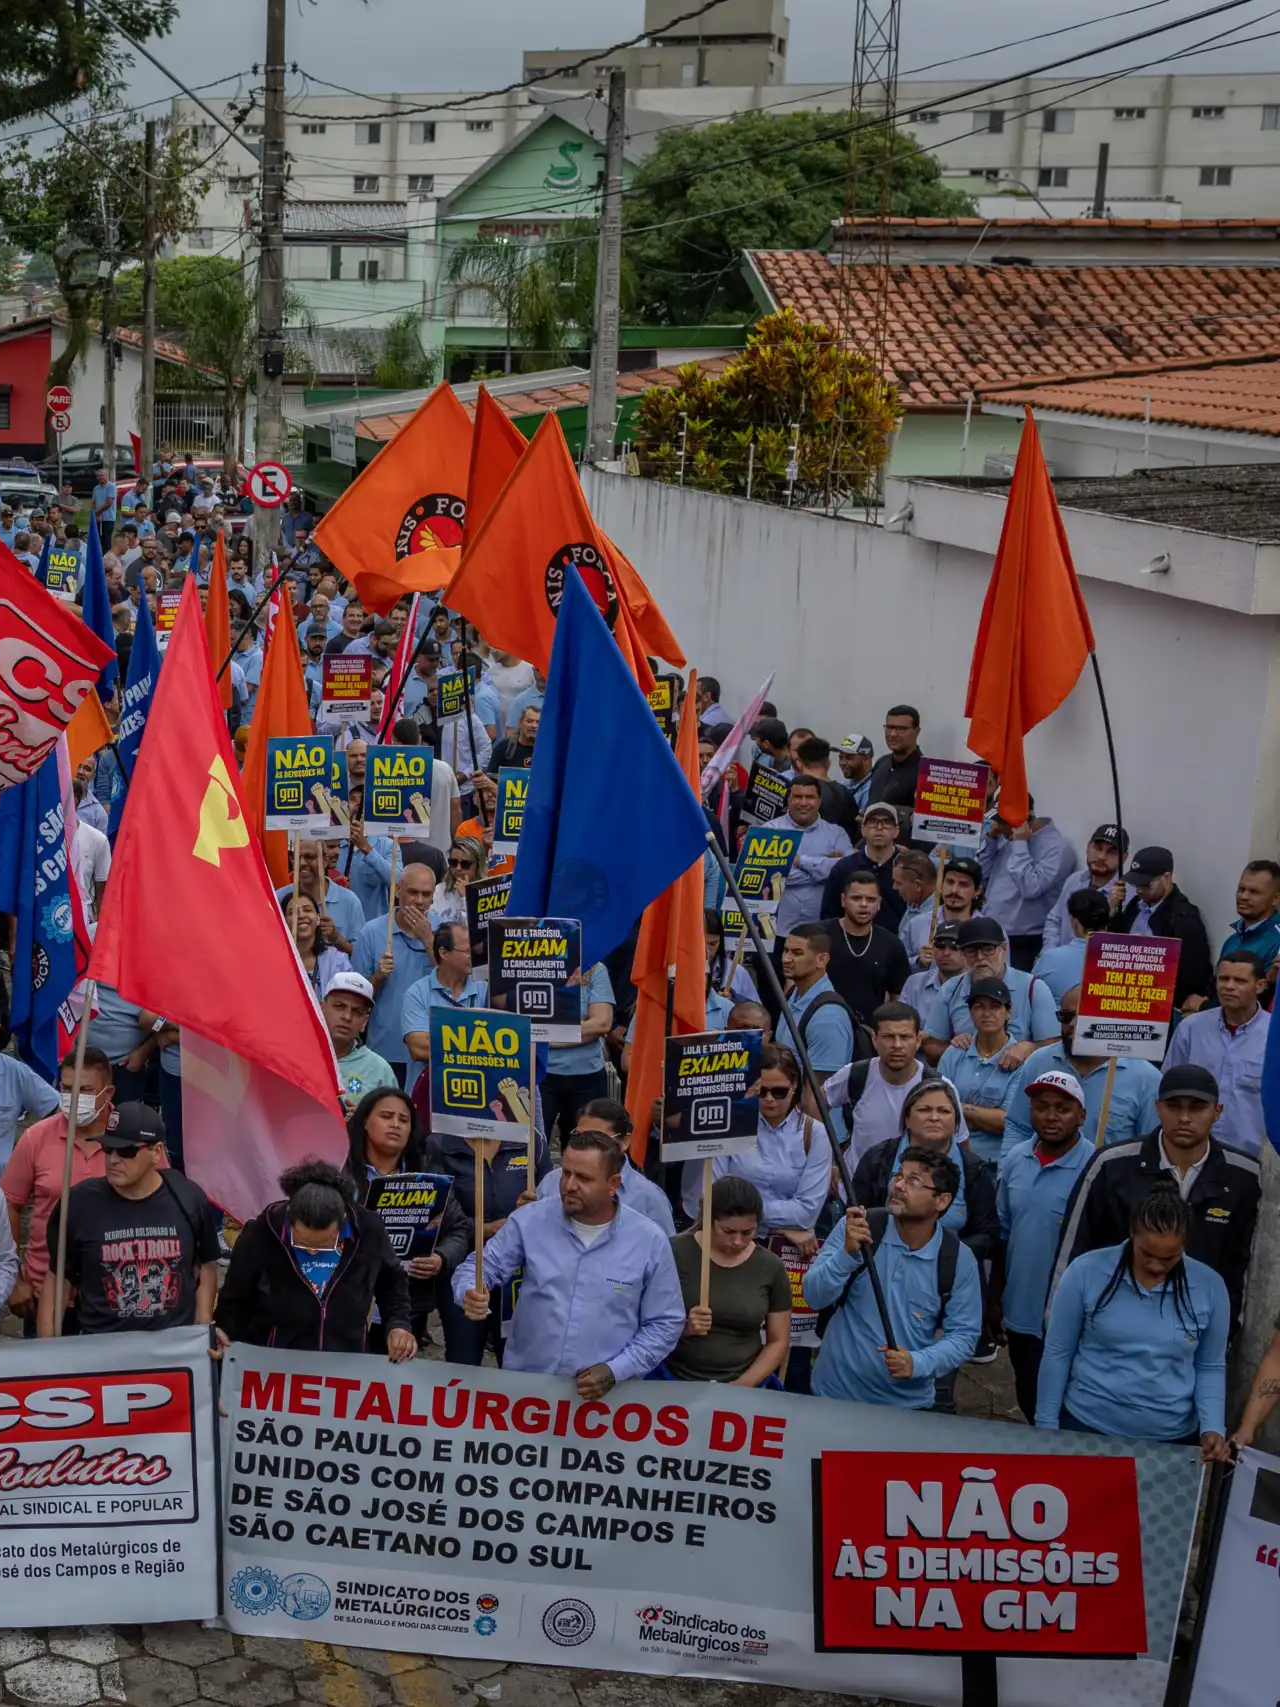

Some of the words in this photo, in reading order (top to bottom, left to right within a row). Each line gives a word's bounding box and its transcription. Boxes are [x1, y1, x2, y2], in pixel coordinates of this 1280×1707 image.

[49, 395, 71, 404] PARE
[262, 471, 278, 497] E
[49, 552, 77, 567] NÃO
[275, 744, 325, 770] NÃO
[373, 752, 425, 777] NÃO
[275, 770, 283, 779] ÀS
[284, 768, 316, 779] DEMISSÕES
[317, 767, 325, 776] NA
[373, 777, 382, 786] ÀS
[383, 777, 415, 787] DEMISSÕES
[416, 777, 425, 786] NA
[279, 786, 298, 802] gm
[754, 775, 788, 796] EXIJAM
[378, 795, 397, 810] gm
[748, 835, 794, 858] NÃO
[504, 928, 522, 938] LULA
[523, 928, 528, 937] E
[529, 927, 563, 939] TARCÍSIO,
[501, 938, 568, 959] EXIJAM
[1101, 943, 1129, 953] EMPRESA
[1129, 945, 1143, 955] QUE
[1144, 946, 1167, 956] RECEBE
[1101, 951, 1131, 961] DINHEIRO
[1131, 953, 1159, 963] PÚBLICO
[501, 968, 516, 979] DAS
[517, 967, 556, 979] DEMISSÕES
[557, 969, 568, 979] NA
[503, 959, 509, 969] O
[510, 959, 565, 969] CANCELAMENTO
[1097, 959, 1124, 970] ISENÇÃO
[1125, 962, 1133, 970] DE
[1133, 963, 1165, 972] IMPOSTOS
[1106, 971, 1124, 983] TEM
[1125, 973, 1137, 984] DE
[1138, 974, 1154, 986] SER
[523, 990, 548, 1009] gm
[1088, 983, 1127, 997] PROIBIDA
[1128, 986, 1139, 999] DE
[1141, 987, 1167, 1001] FAZER
[1100, 999, 1150, 1014] DEMISSÕES!
[441, 1019, 520, 1055] NÃO
[683, 1045, 701, 1055] LULA
[702, 1044, 708, 1053] E
[709, 1041, 744, 1053] TARCÍSIO,
[443, 1053, 455, 1064] ÀS
[456, 1054, 505, 1068] DEMISSÕES
[507, 1058, 520, 1069] NA
[678, 1051, 749, 1076] EXIJAM
[450, 1077, 479, 1099] gm
[680, 1077, 686, 1086] O
[686, 1072, 745, 1086] CANCELAMENTO
[677, 1086, 692, 1097] DAS
[693, 1082, 735, 1096] DEMISSÕES
[735, 1082, 746, 1091] NA
[698, 1105, 724, 1125] gm
[104, 1228, 134, 1240] DERRUBAR
[135, 1226, 168, 1237] BOLSONARO
[240, 1370, 689, 1447] METALÚRGICOS
[709, 1410, 787, 1459] DE
[235, 1417, 303, 1447] SÃO
[314, 1427, 422, 1459] PAULO
[432, 1438, 454, 1463] E
[463, 1440, 549, 1468] MOGI
[561, 1447, 625, 1475] DAS
[636, 1454, 772, 1491] CRUZES
[234, 1451, 361, 1485] UNIDOS
[371, 1466, 445, 1494] COM
[455, 1473, 499, 1498] OS
[508, 1476, 777, 1524] COMPANHEIROS
[23, 1500, 93, 1516] SINDICAL
[97, 1500, 107, 1513] E
[110, 1497, 184, 1514] POPULAR
[884, 1466, 1069, 1541] NÃO
[231, 1482, 274, 1509] DE
[283, 1487, 351, 1516] SÃO
[361, 1496, 448, 1527] JOSÉ
[458, 1506, 525, 1533] DOS
[535, 1512, 675, 1544] CAMPOS
[685, 1523, 707, 1547] E
[29, 1541, 57, 1558] dos
[61, 1540, 158, 1558] Metalúrgicos
[162, 1538, 181, 1553] de
[228, 1512, 295, 1543] SÃO
[305, 1523, 461, 1558] CAETANO
[472, 1539, 518, 1564] DO
[527, 1544, 593, 1571] SUL
[23, 1562, 51, 1578] dos
[55, 1560, 117, 1579] Campos
[121, 1563, 130, 1576] e
[134, 1559, 185, 1578] Região
[834, 1538, 888, 1580] ÀS
[897, 1542, 1120, 1585] DEMISSÕES
[336, 1581, 430, 1603] SINDICATO
[433, 1590, 470, 1605] DOS
[334, 1597, 471, 1622] METALÚRGICOS
[874, 1586, 964, 1630] NA
[982, 1589, 1078, 1632] GM
[345, 1615, 362, 1624] SÃO
[363, 1618, 390, 1627] PAULO
[397, 1621, 419, 1629] MOGI
[420, 1623, 436, 1631] DAS
[437, 1624, 469, 1634] CRUZES
[662, 1609, 739, 1636] Sindicato
[740, 1624, 767, 1640] dos
[638, 1624, 741, 1653] Metalúrgicos
